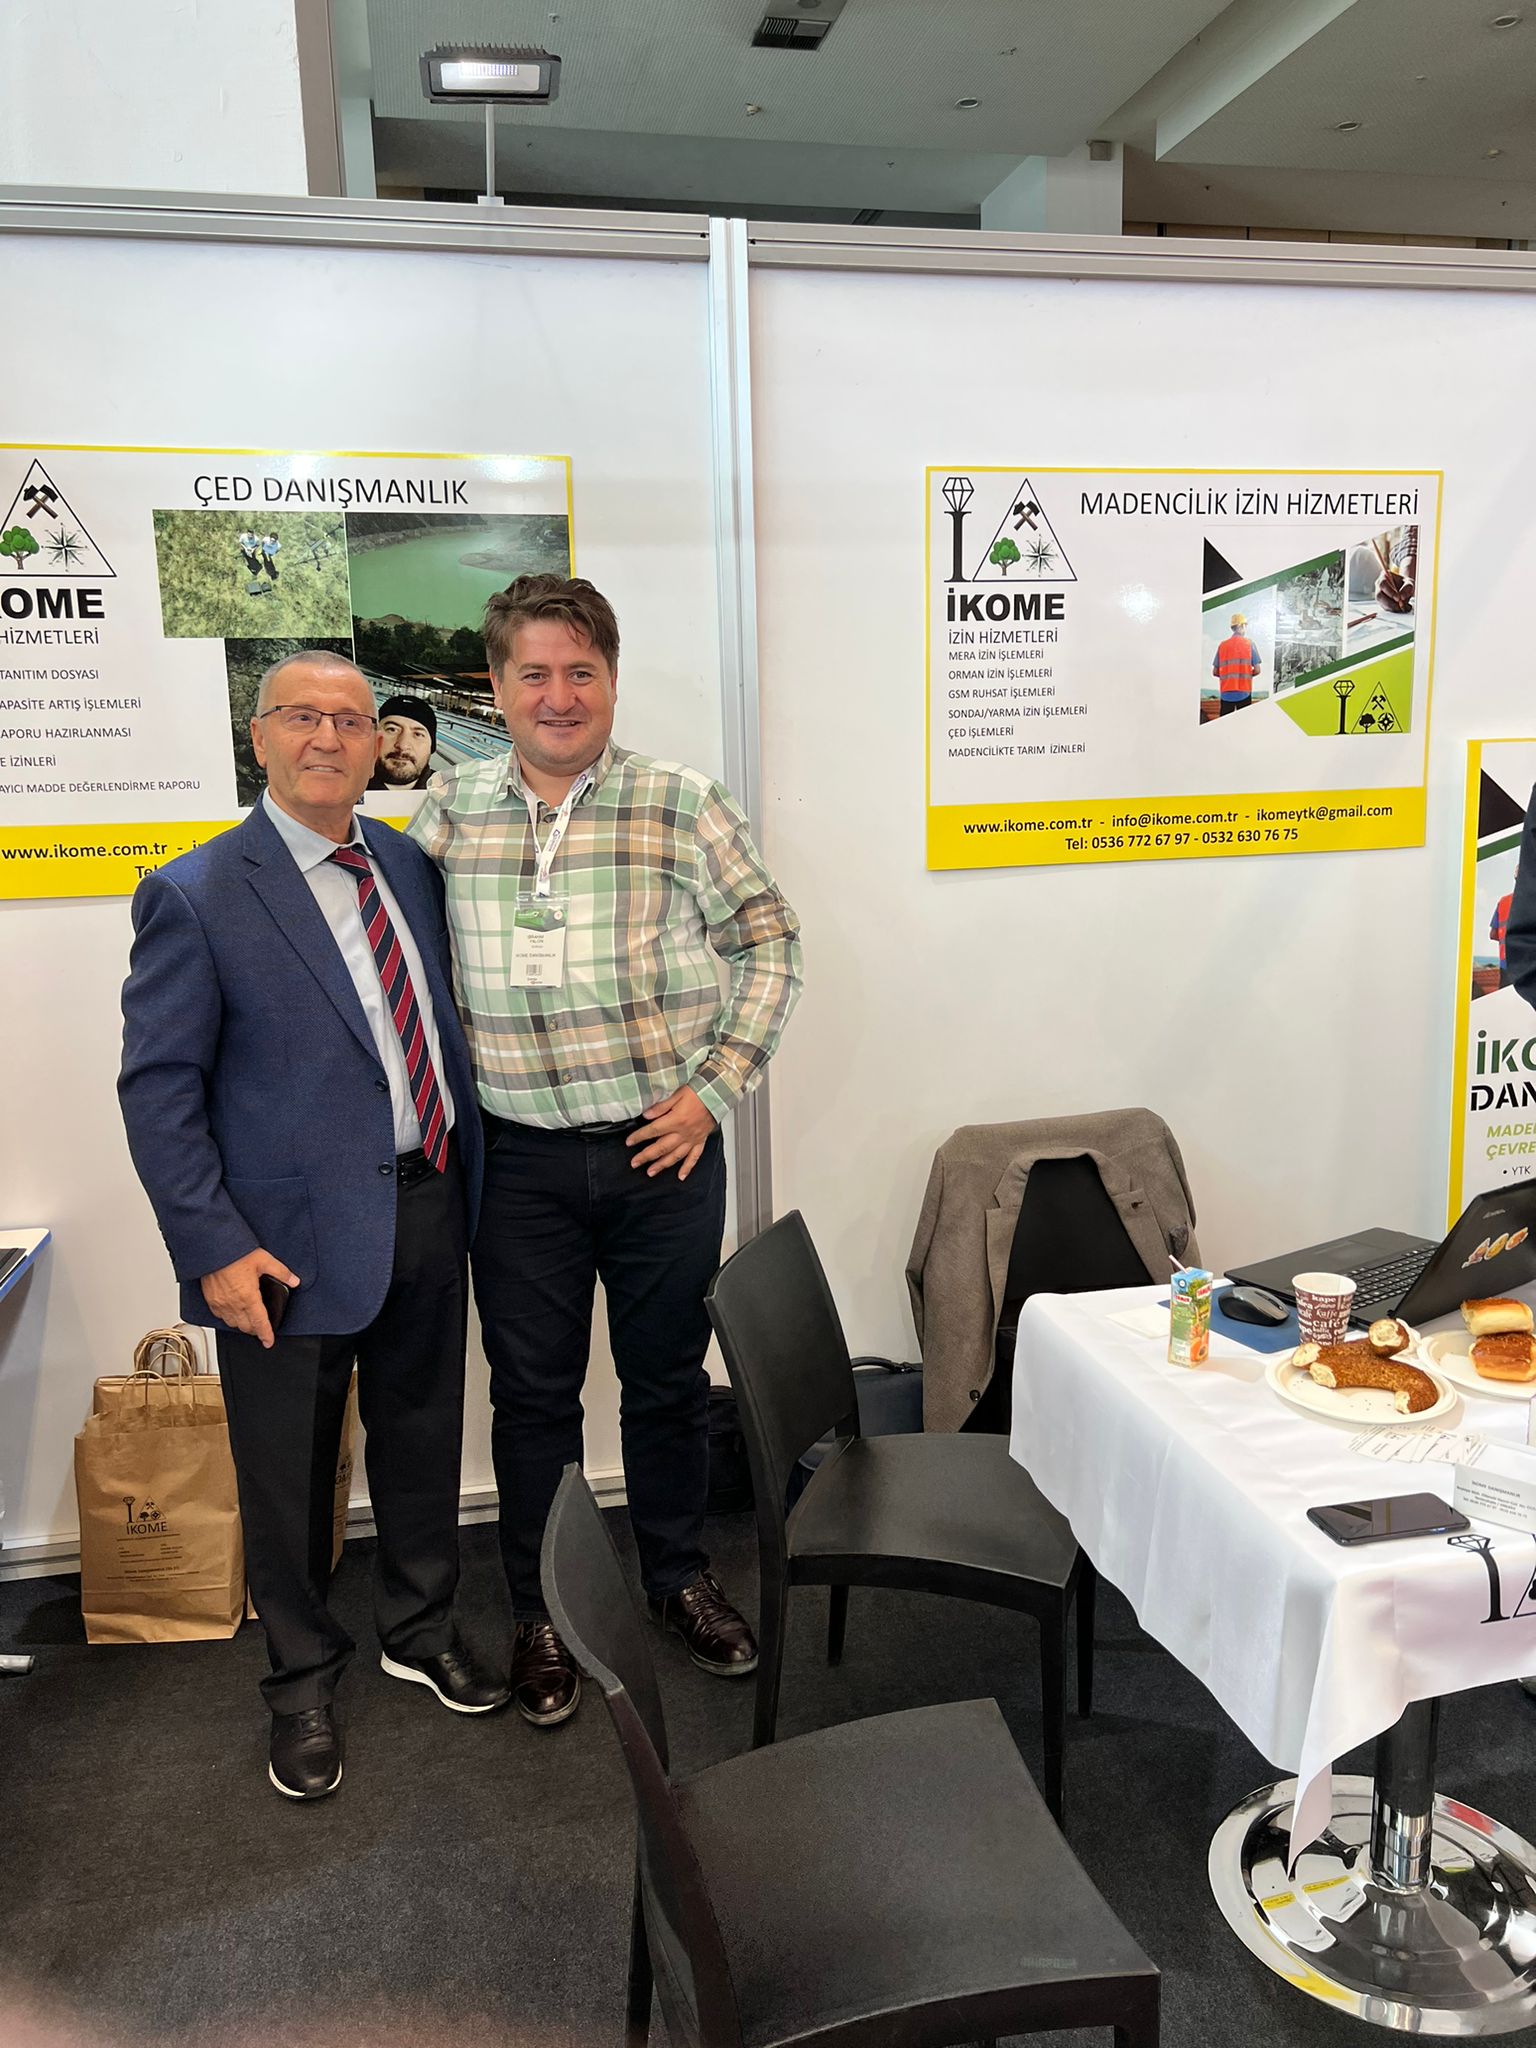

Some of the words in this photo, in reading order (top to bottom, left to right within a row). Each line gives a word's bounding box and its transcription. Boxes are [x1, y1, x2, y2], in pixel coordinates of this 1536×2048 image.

[194, 476, 251, 506] ÇED
[263, 477, 469, 509] DANIŞMANLIK
[1080, 487, 1228, 515] MADENCİLİK
[1235, 487, 1278, 515] İZİN
[1287, 487, 1419, 515] HİZMETLERİ
[947, 587, 1065, 622] İKOME
[949, 628, 975, 645] İZİN
[979, 627, 1058, 644] HİZMETLERİ
[948, 650, 976, 661] MERA
[978, 649, 996, 660] İZİN
[998, 648, 1044, 662] İŞLEMLERİ
[51, 669, 99, 680] DOSYASI
[948, 669, 984, 680] ORMAN
[987, 668, 1005, 679] İZİN
[1007, 667, 1053, 681] İŞLEMLERİ
[948, 689, 970, 699] GSM
[972, 688, 1008, 698] RUHSAT
[1010, 686, 1056, 699] İŞLEMLERİ
[49, 699, 81, 712] ARTIŞ
[84, 697, 142, 711] İŞLEMLERİ
[948, 707, 1021, 719] SONDAJ/YARMA
[1023, 705, 1041, 716] İZİN
[1043, 704, 1088, 718] İŞLEMLERİ
[45, 727, 131, 739] HAZIRLANMASI
[948, 728, 966, 739] ÇED
[968, 725, 1014, 739] İŞLEMLERİ
[948, 746, 1015, 758] MADENCİLİKTE
[1017, 745, 1045, 755] TARIM
[1050, 742, 1086, 754] İZİNLERİ
[10, 755, 57, 767] İZİNLERİ
[27, 783, 66, 793] MADDE
[69, 780, 156, 793] DEĞERLENDİRME
[158, 781, 201, 791] RAPORU
[963, 817, 1093, 834] www.ikome.com.tr
[1112, 810, 1239, 828] info@ikome.com.tr
[1256, 804, 1393, 823] ikomeytk@gmail.com
[1065, 837, 1088, 850] Tel:
[1091, 836, 1124, 849] 0536
[1127, 834, 1151, 848] 772
[1155, 833, 1171, 846] 67
[1174, 833, 1190, 845] 97
[1201, 831, 1234, 845] 0532
[1237, 830, 1261, 843] 630
[1264, 829, 1280, 841] 76
[1283, 828, 1298, 840] 75
[2, 842, 168, 859] www.ikome.com.tr
[1486, 1122, 1536, 1138] MADE
[1512, 1165, 1532, 1176] YTK
